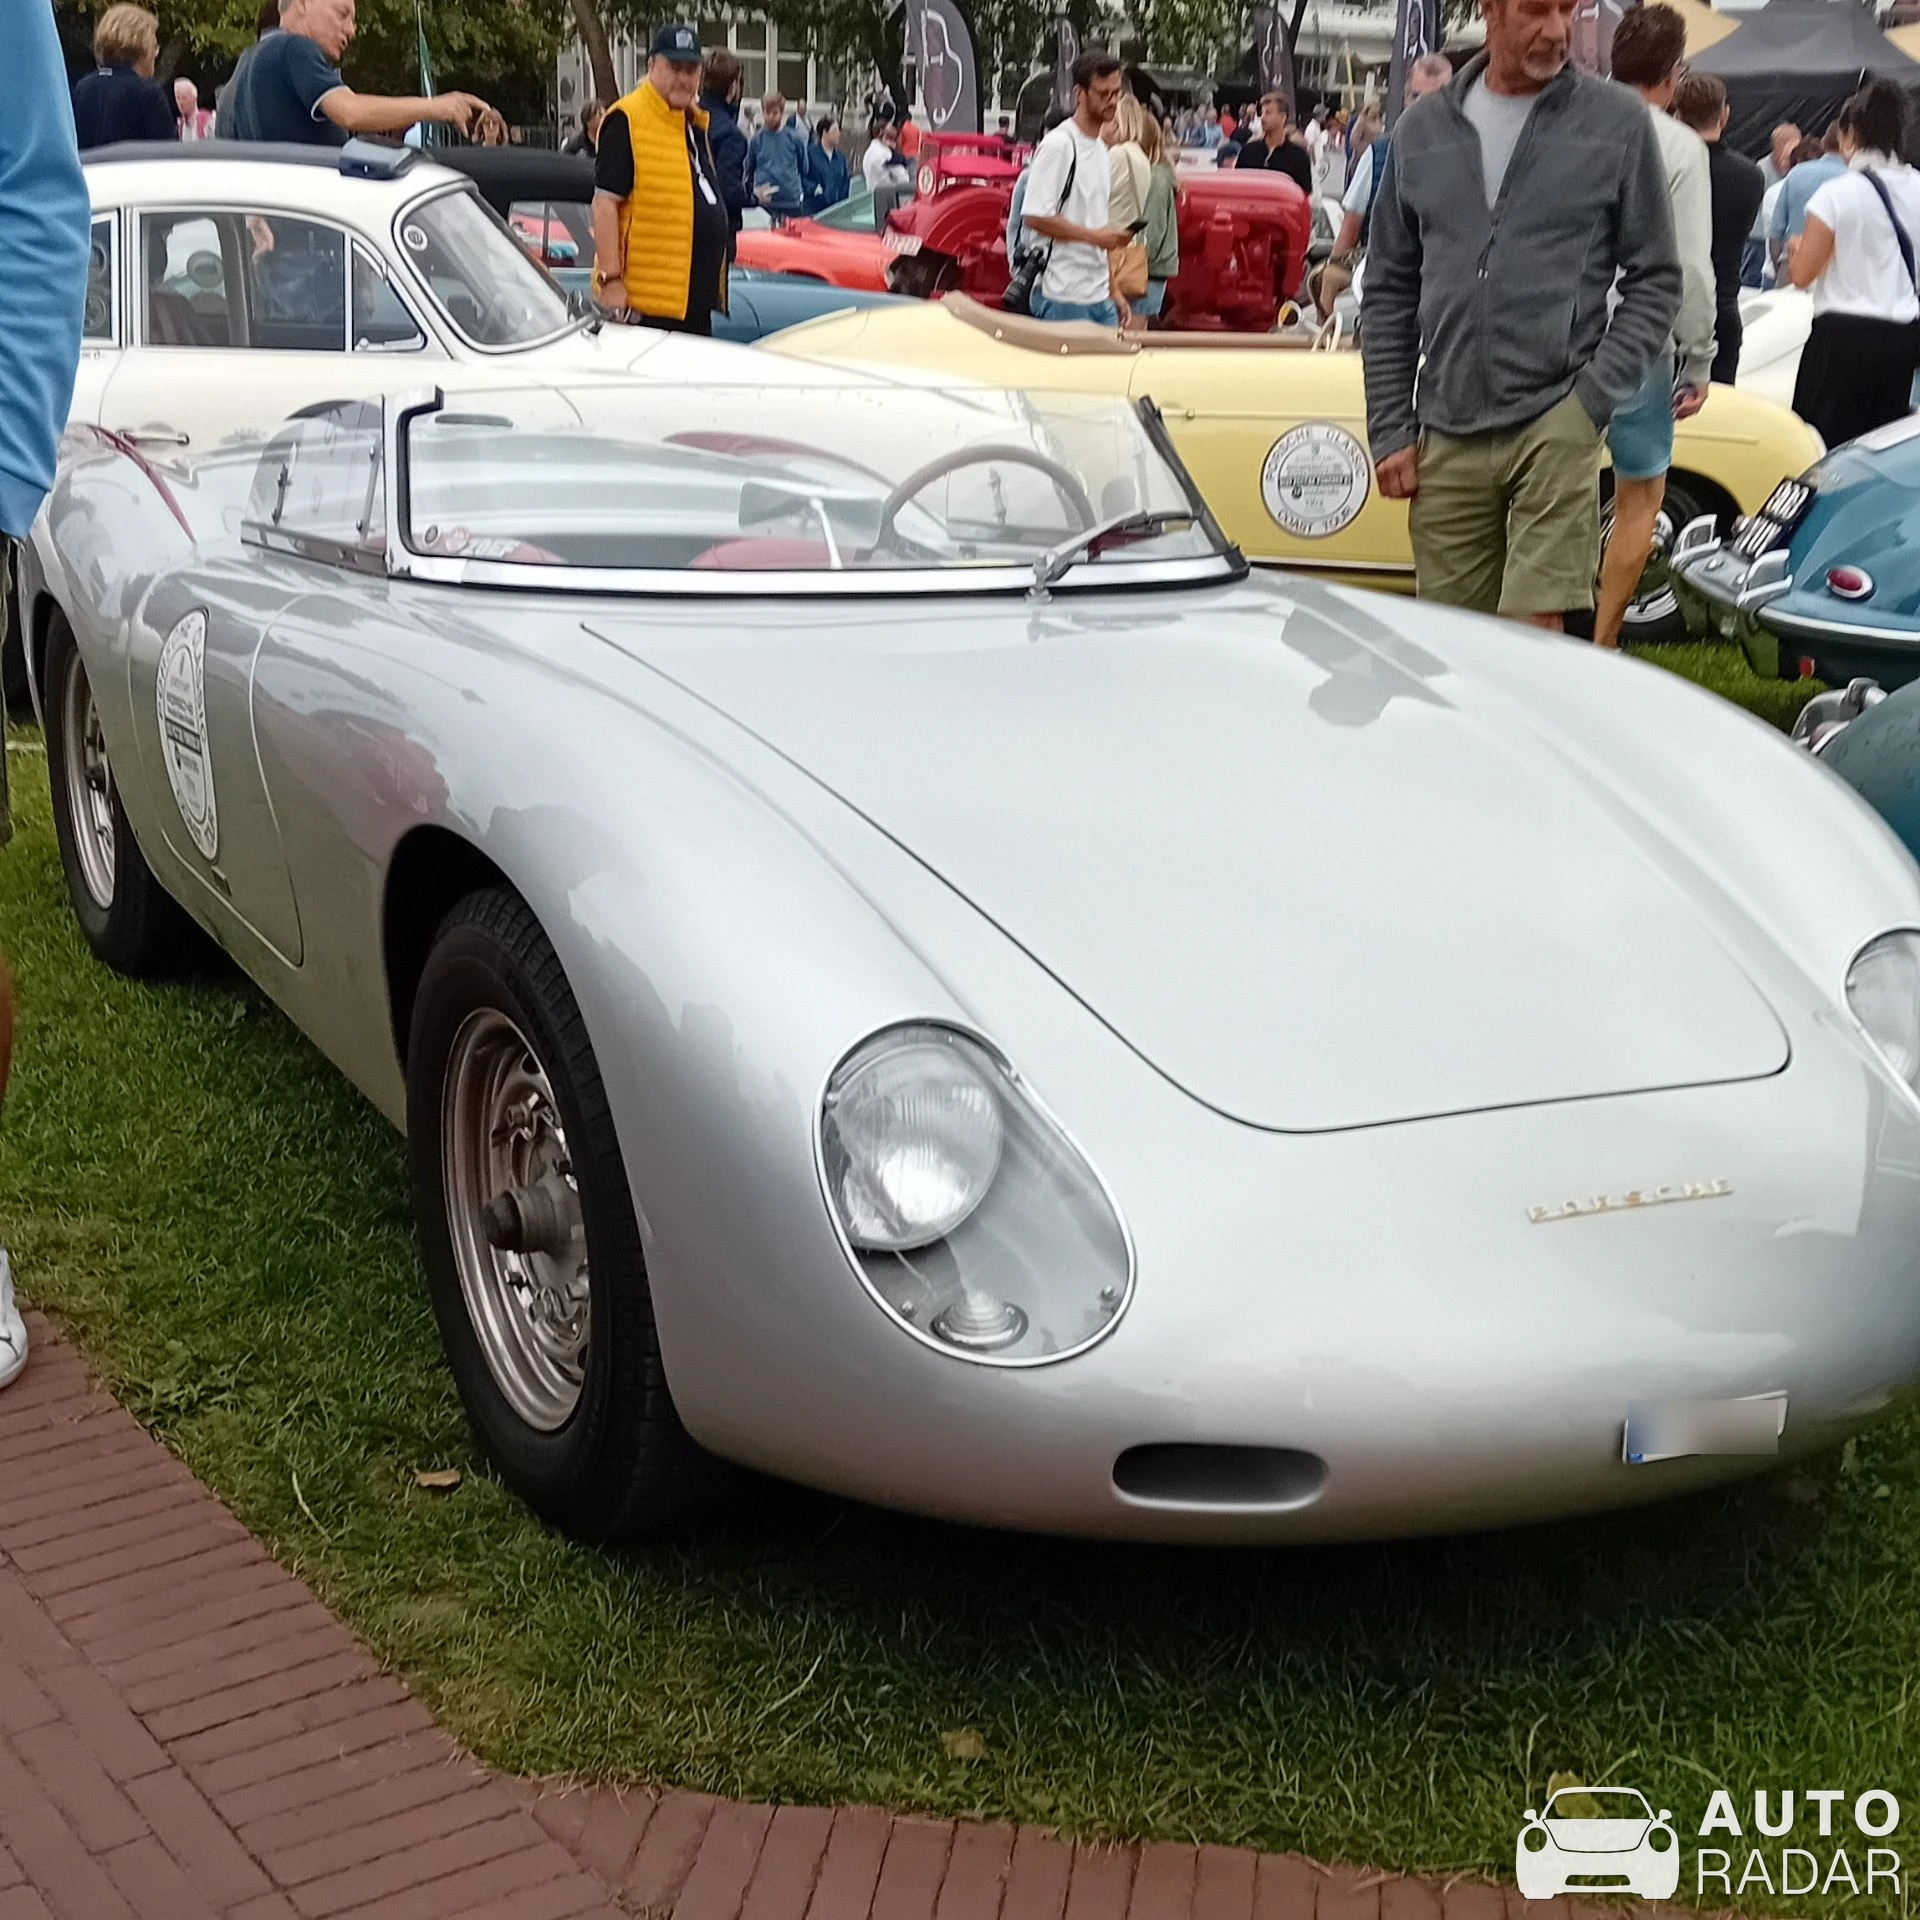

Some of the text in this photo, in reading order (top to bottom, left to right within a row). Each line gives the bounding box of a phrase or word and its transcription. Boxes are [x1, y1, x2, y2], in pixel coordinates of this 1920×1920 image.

[1266, 427, 1366, 481] PORSCHE CLASSIC
[1277, 505, 1352, 535] COAST TOUR
[1525, 1176, 1735, 1224] PORSCHE
